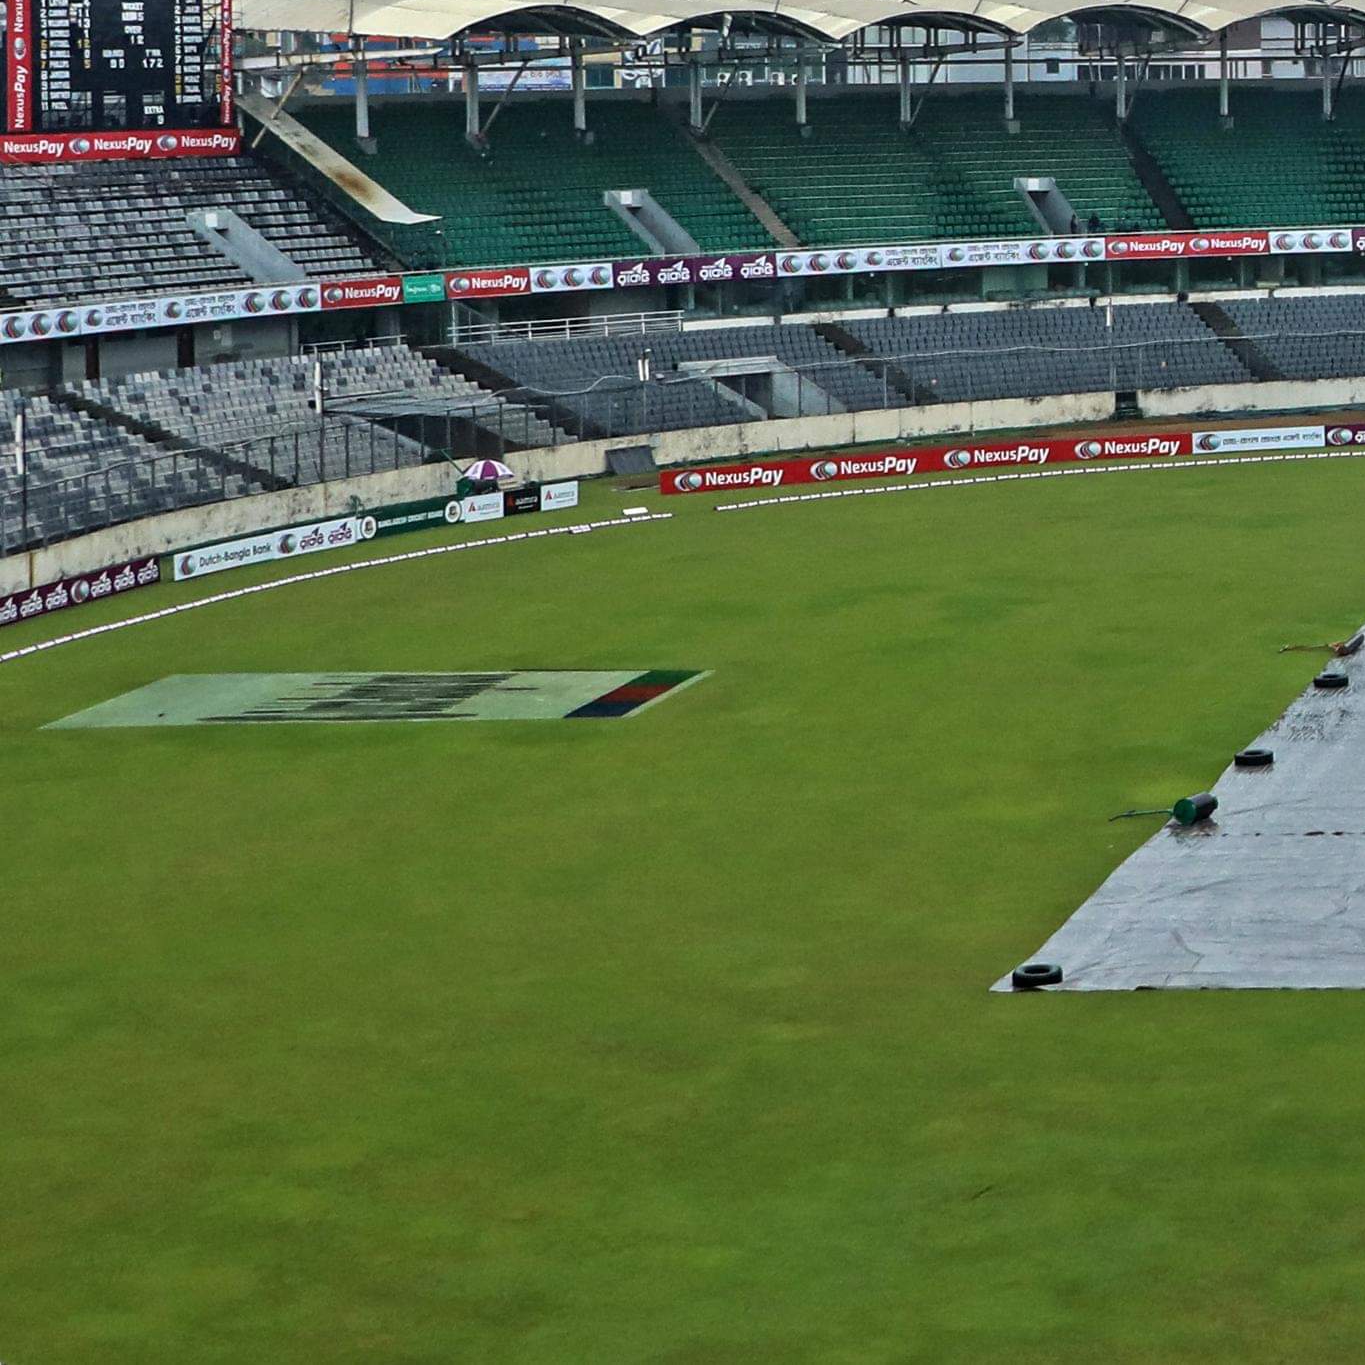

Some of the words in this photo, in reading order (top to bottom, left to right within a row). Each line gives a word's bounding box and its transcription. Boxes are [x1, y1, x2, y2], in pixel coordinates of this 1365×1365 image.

[142, 59, 164, 68] 172
[15, 66, 28, 128] NexusPay
[4, 141, 64, 156] NexusPay
[94, 136, 152, 153] NexusPay
[181, 134, 237, 151] NexusPay
[1130, 237, 1185, 255] NexusPay
[1211, 235, 1266, 252] NexusPay
[345, 283, 400, 301] NexusPay
[472, 275, 528, 292] NexusPay
[706, 467, 783, 486] NexusPay
[841, 457, 917, 475] NexusPay
[974, 446, 1049, 464] NexusPay
[1104, 438, 1180, 455] NexusPay
[199, 546, 250, 568] Dutch-Bangla
[252, 542, 272, 559] Bank
